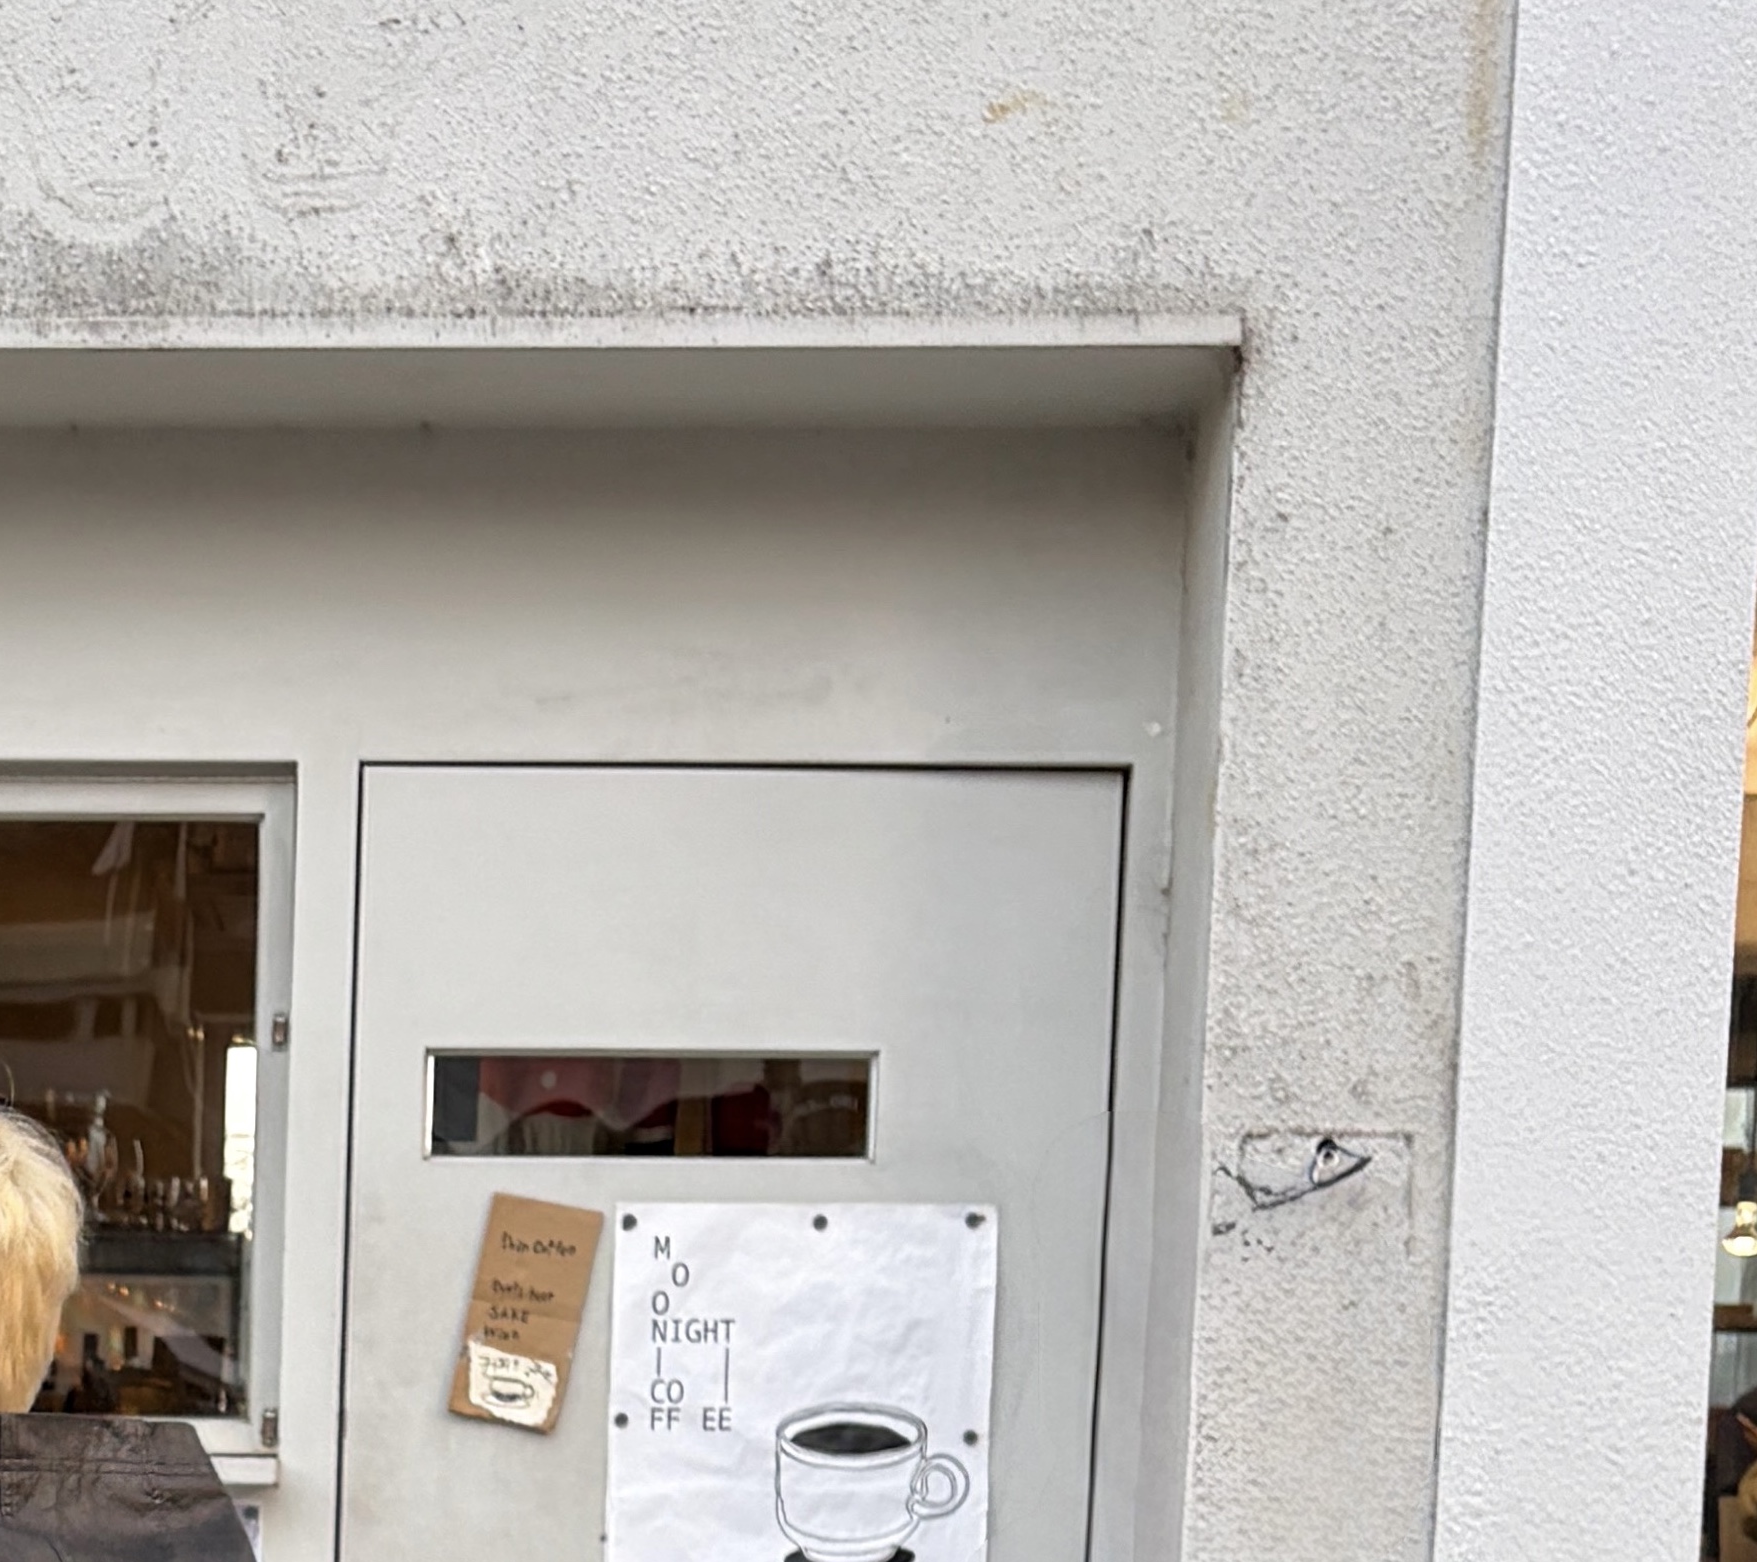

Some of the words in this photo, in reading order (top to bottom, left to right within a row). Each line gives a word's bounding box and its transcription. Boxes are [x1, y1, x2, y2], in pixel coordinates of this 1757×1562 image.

[654, 1235, 671, 1260] M
[671, 1262, 690, 1287] O
[651, 1290, 670, 1316] O
[651, 1318, 736, 1344] NIGHT
[650, 1378, 685, 1405] CO
